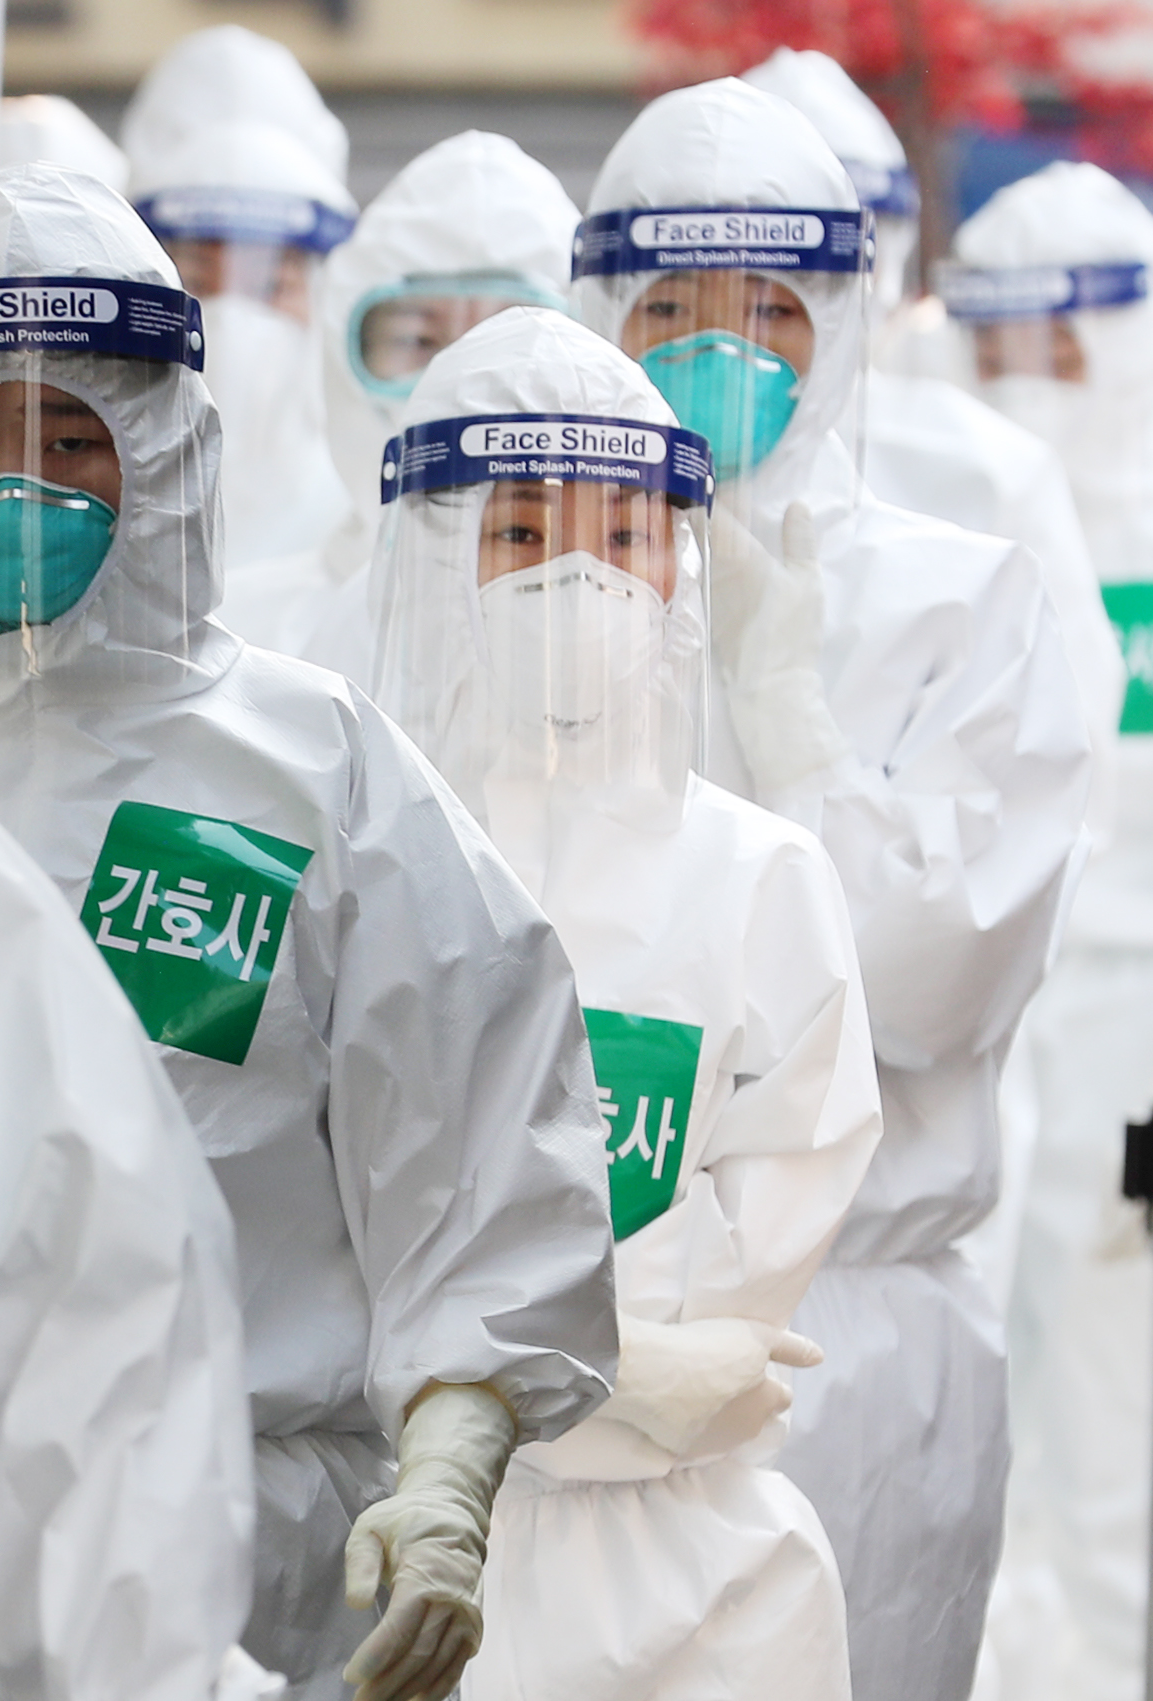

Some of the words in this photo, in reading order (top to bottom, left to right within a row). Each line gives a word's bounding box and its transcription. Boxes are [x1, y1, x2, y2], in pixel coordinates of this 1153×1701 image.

[654, 219, 715, 243] Face
[725, 217, 805, 243] Shield
[657, 250, 694, 265] Direct
[695, 249, 739, 267] Splash
[740, 249, 801, 265] Protection
[18, 329, 89, 344] Protection
[484, 427, 551, 452] Face
[561, 426, 646, 457] Shield
[488, 461, 526, 474] Direct
[528, 460, 574, 477] Splash
[577, 462, 640, 479] Protection
[95, 863, 272, 982] 간호사
